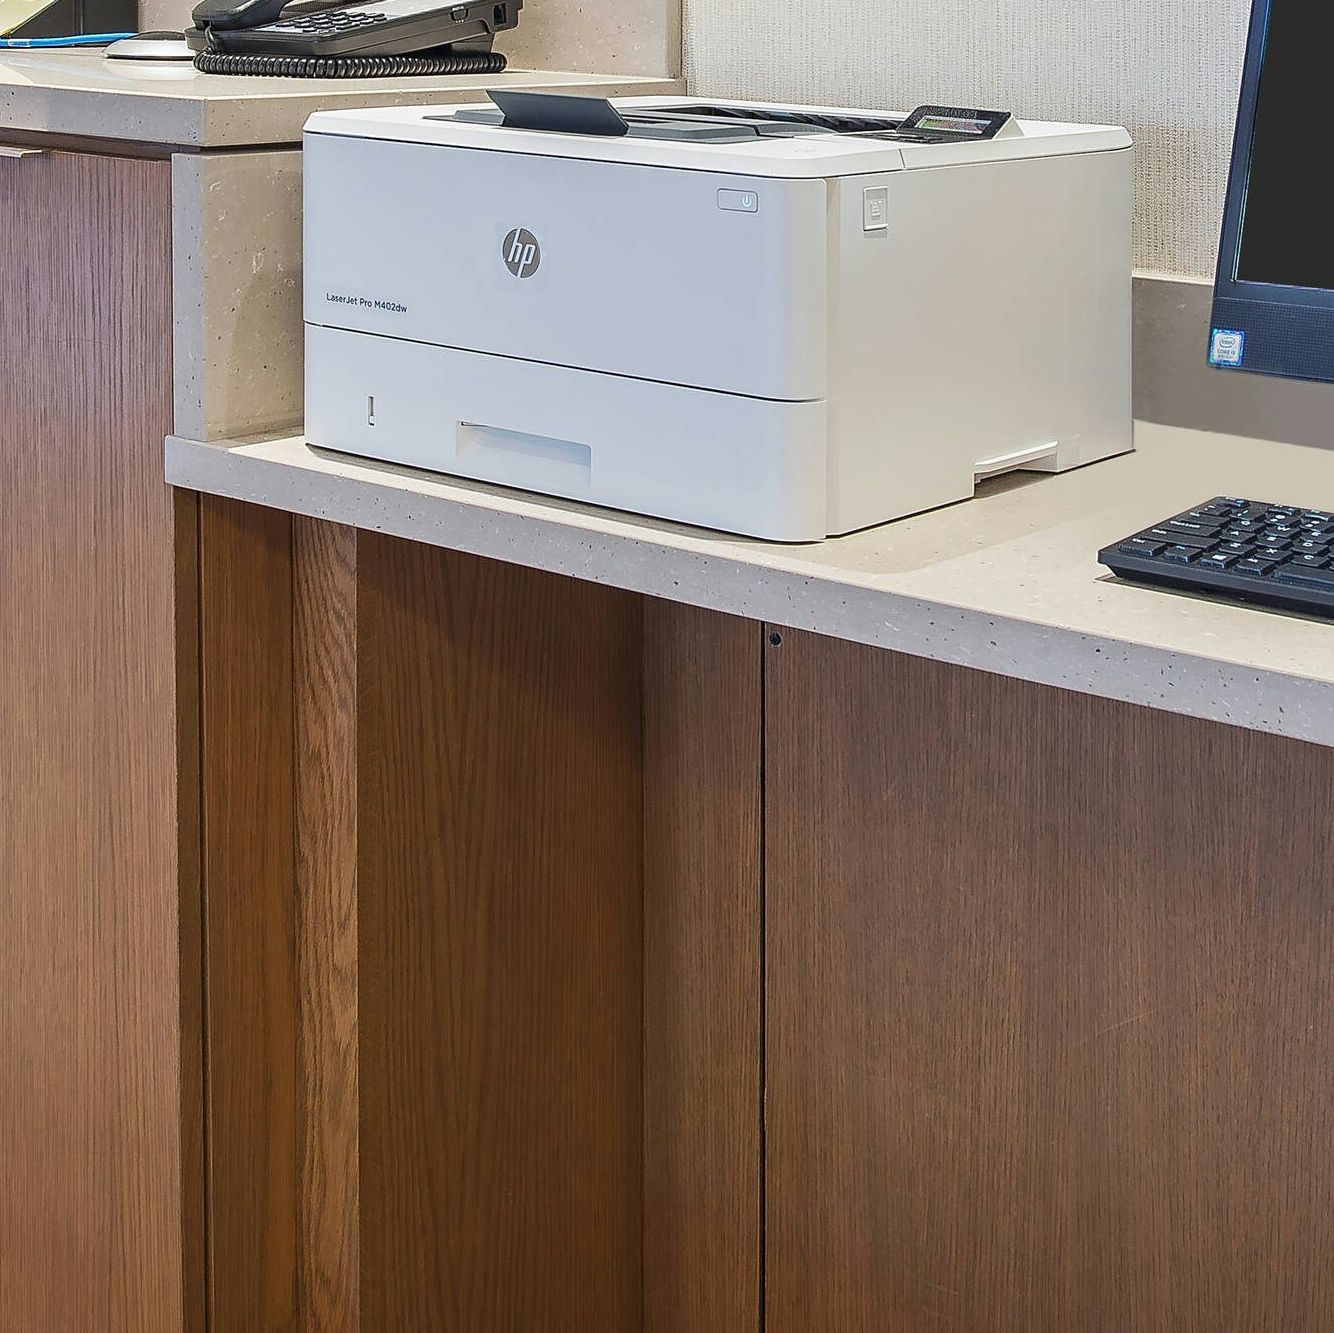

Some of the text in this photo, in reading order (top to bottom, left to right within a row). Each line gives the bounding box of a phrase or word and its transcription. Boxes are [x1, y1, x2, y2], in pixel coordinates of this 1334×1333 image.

[507, 227, 537, 278] hp
[326, 292, 408, 314] LaserJet Pro M402dw
